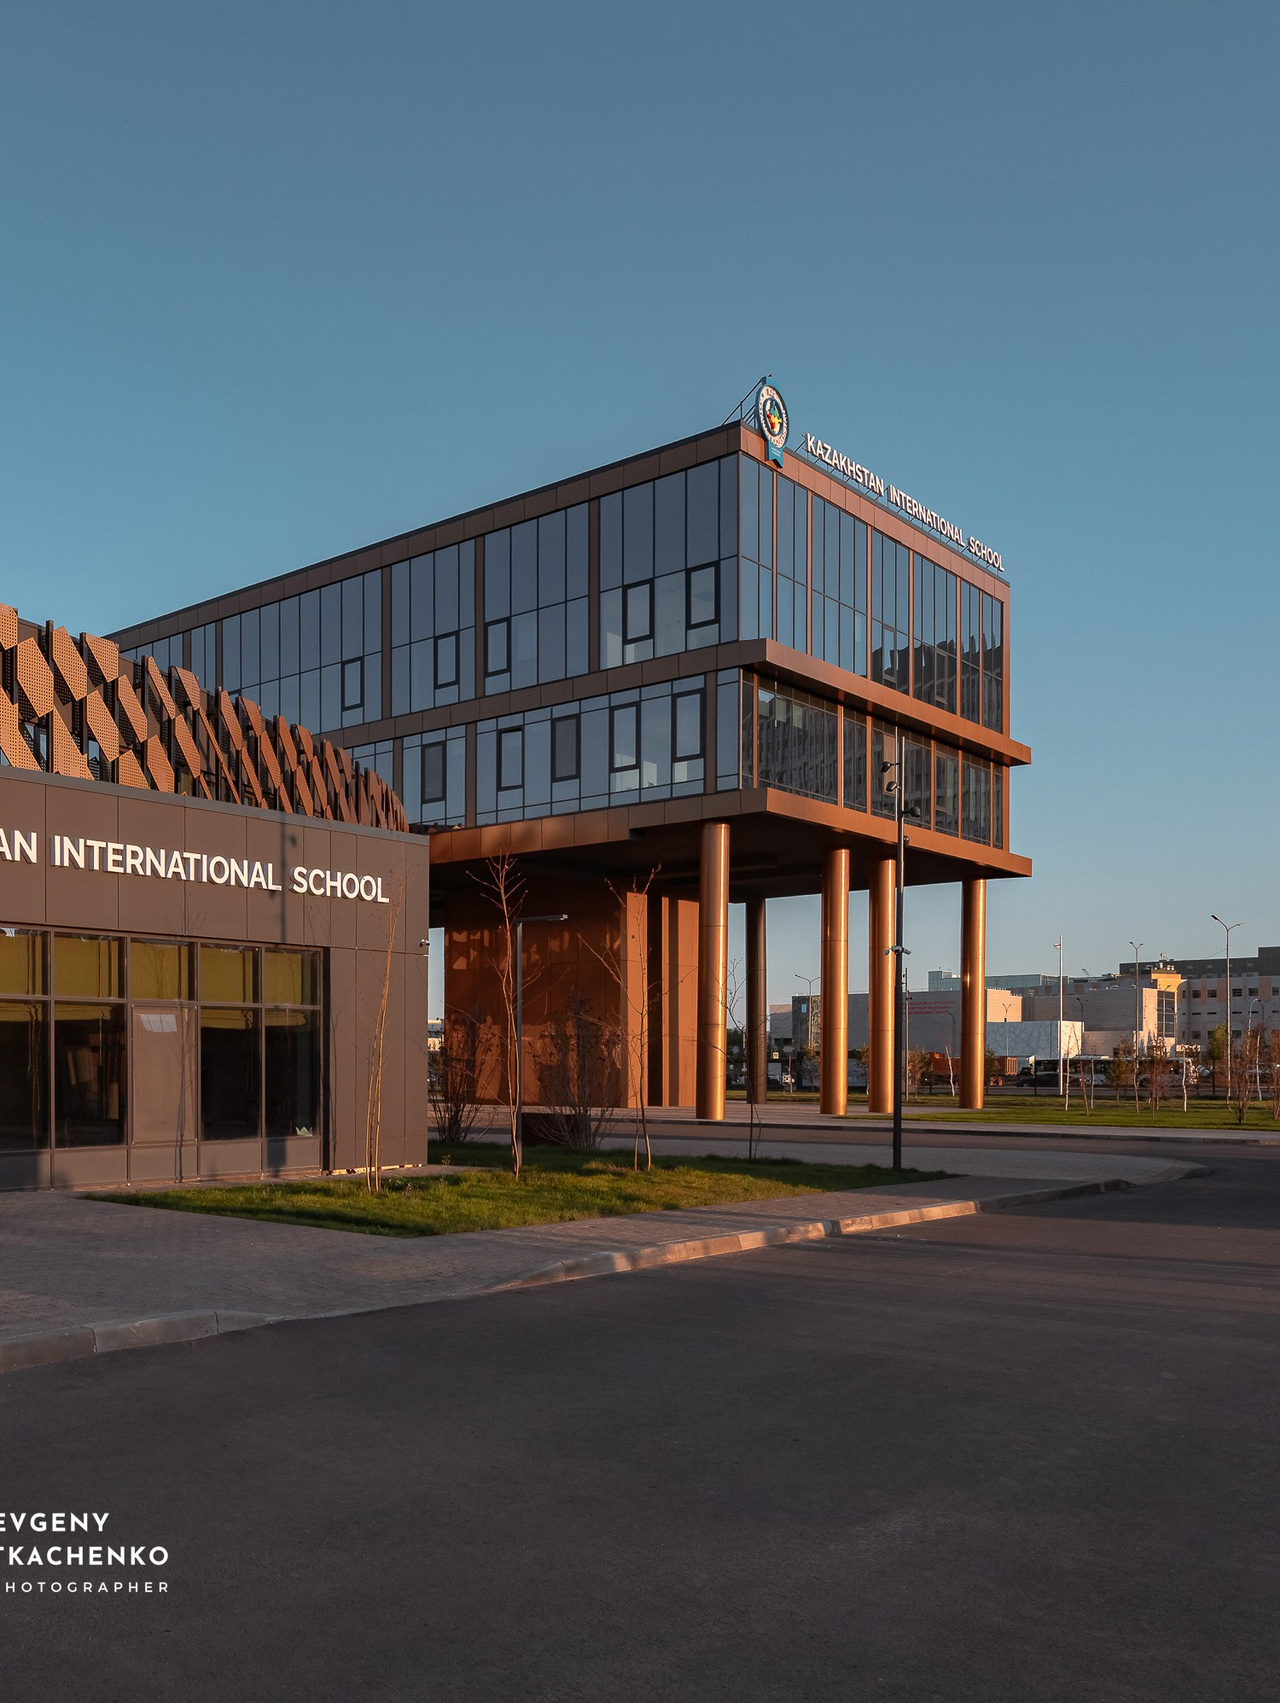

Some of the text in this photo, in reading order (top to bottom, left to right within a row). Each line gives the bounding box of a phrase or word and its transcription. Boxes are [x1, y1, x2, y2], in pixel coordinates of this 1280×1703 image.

[806, 432, 1005, 572] KAZAKHSTAN INTERNATIONAL SCHOOL
[53, 835, 282, 892] INTERNATIONAL
[291, 866, 390, 903] SCHOOL
